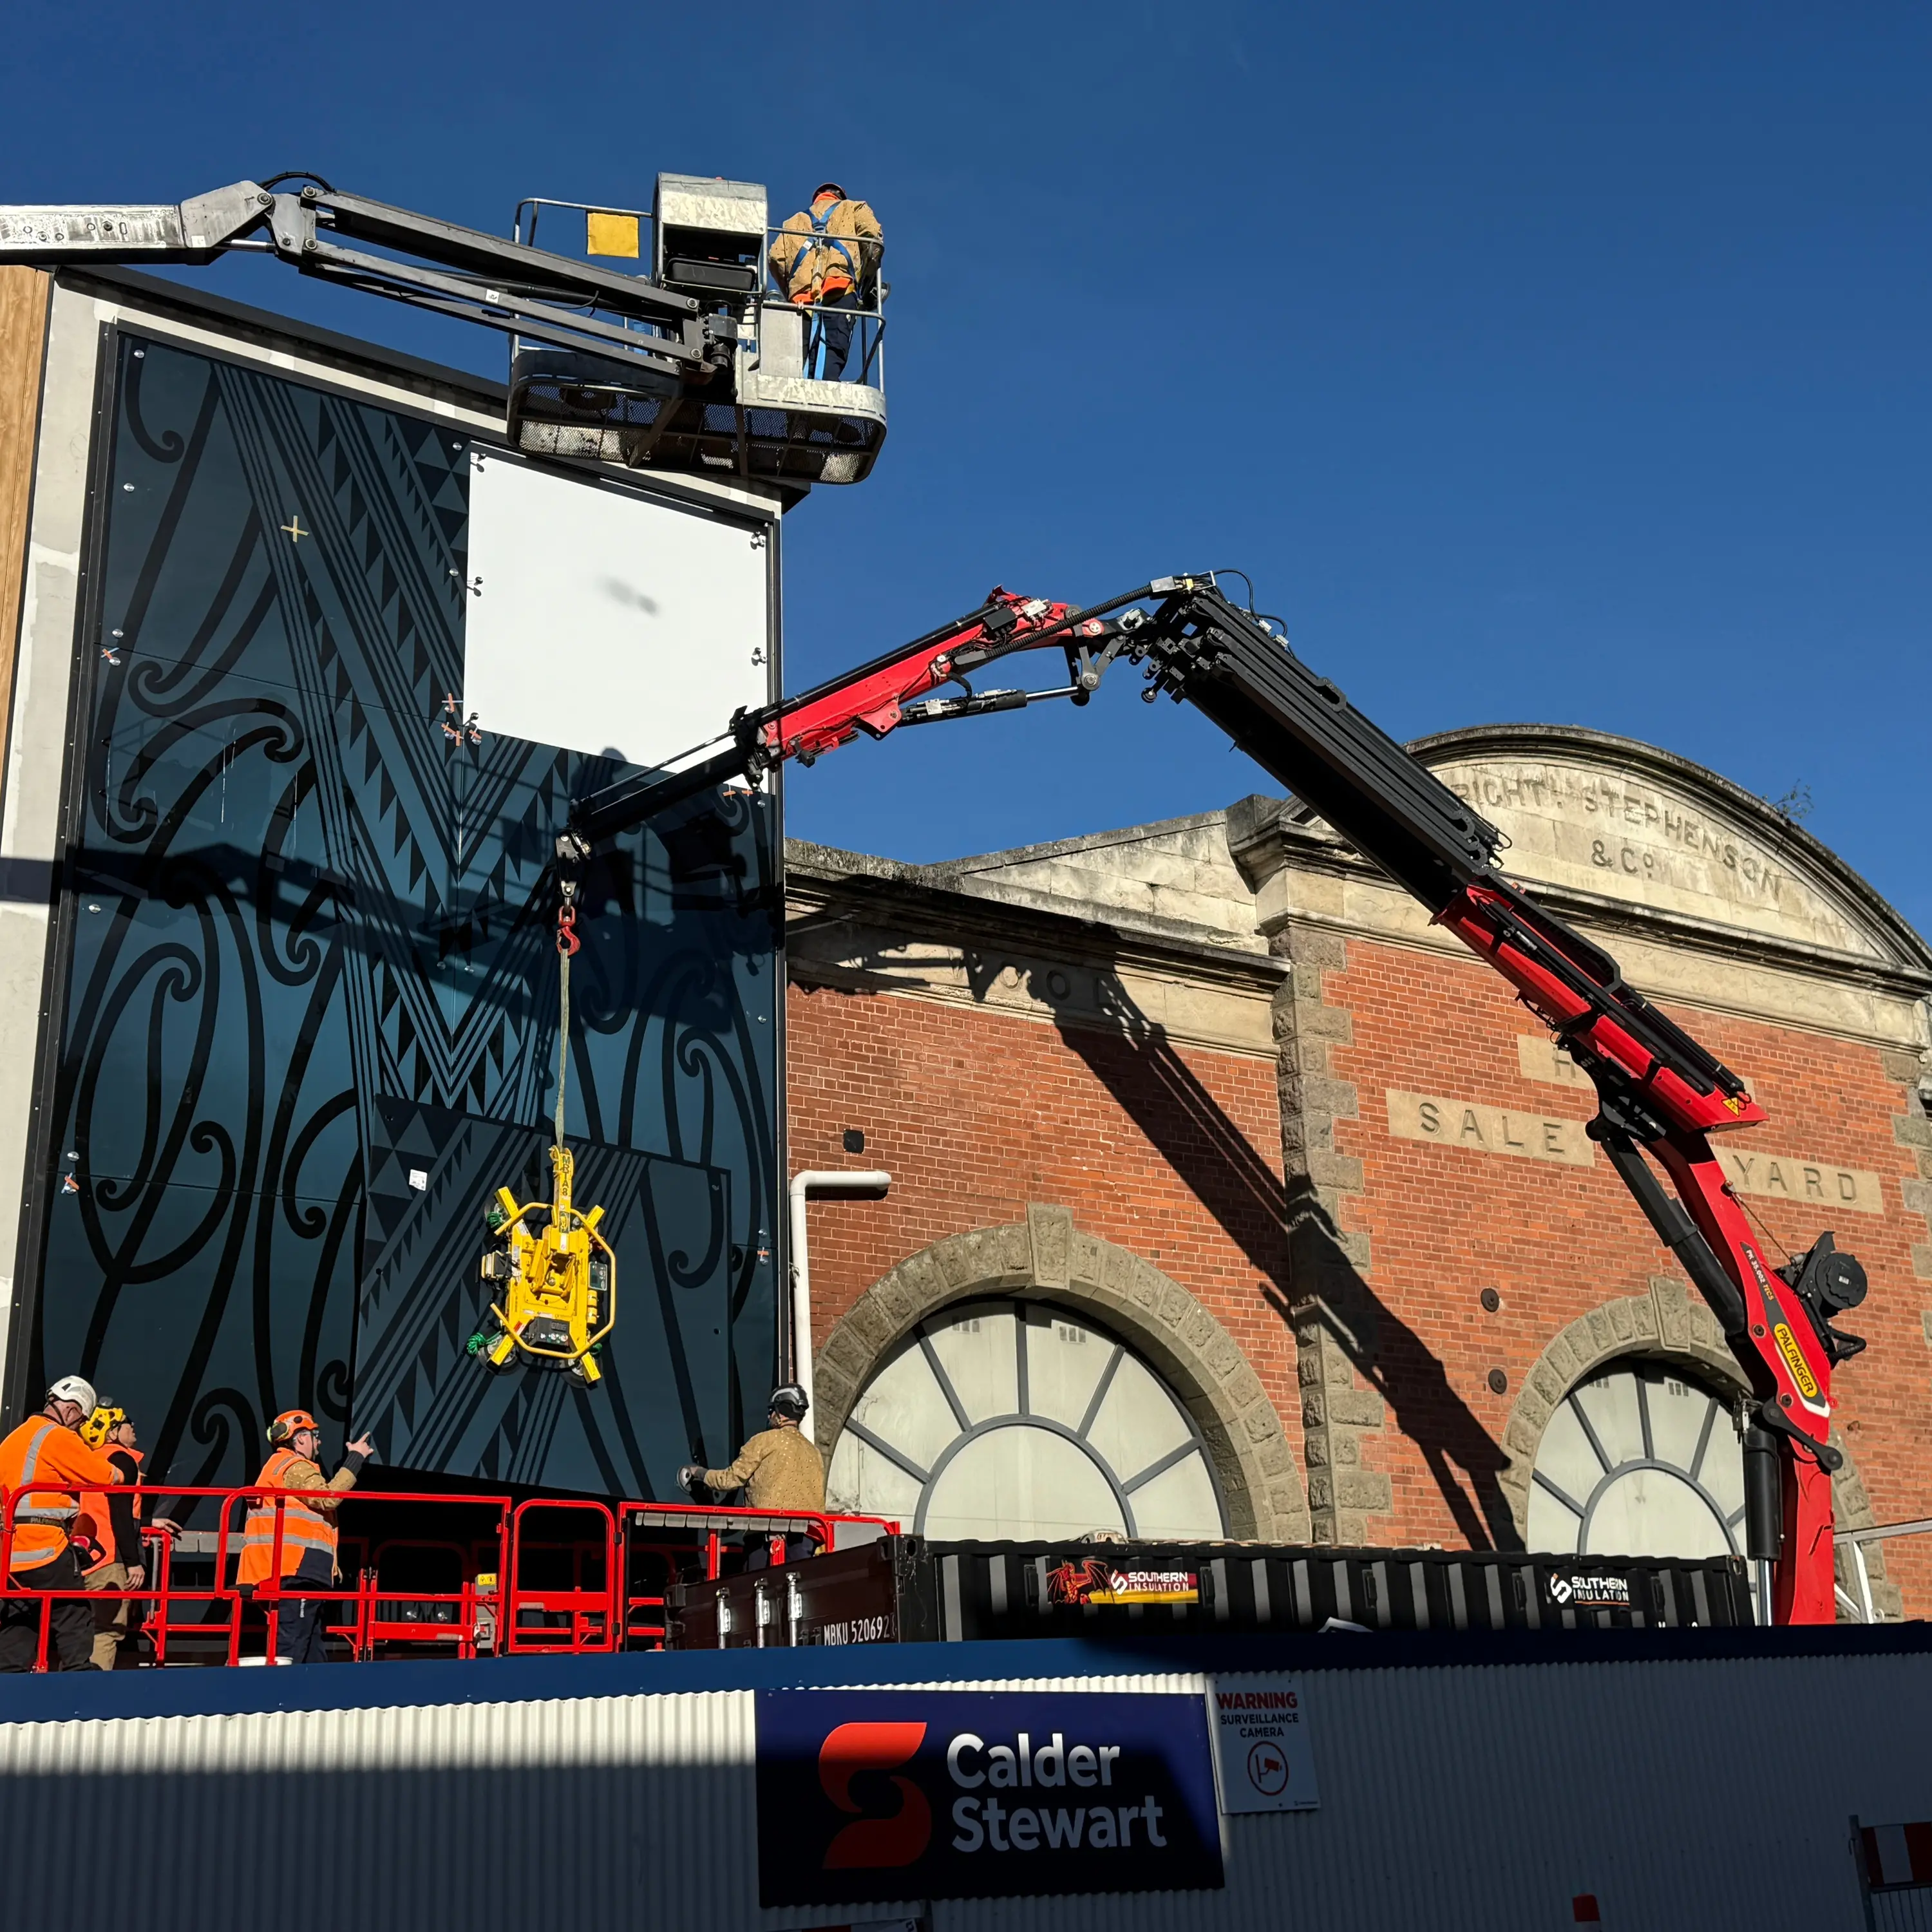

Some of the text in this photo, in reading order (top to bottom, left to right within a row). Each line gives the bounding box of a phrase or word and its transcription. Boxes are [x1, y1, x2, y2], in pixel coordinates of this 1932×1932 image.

[1582, 784, 1781, 902] STEPHENSON
[1591, 839, 1613, 868] &
[1418, 1102, 1858, 1204] SALE YARD
[1745, 1249, 1754, 1260] PK
[1777, 1327, 1815, 1394] PALFINGER
[1128, 1571, 1188, 1583] SOUTHERN
[1129, 1582, 1189, 1592] INSULATION
[824, 1622, 848, 1646] MBKU
[1215, 1692, 1298, 1710] WARNING
[1220, 1713, 1299, 1725] SURVEILLANCE
[1240, 1727, 1284, 1738] CAMERA
[947, 1733, 1121, 1788] Calder
[952, 1795, 1168, 1852] Stewart
